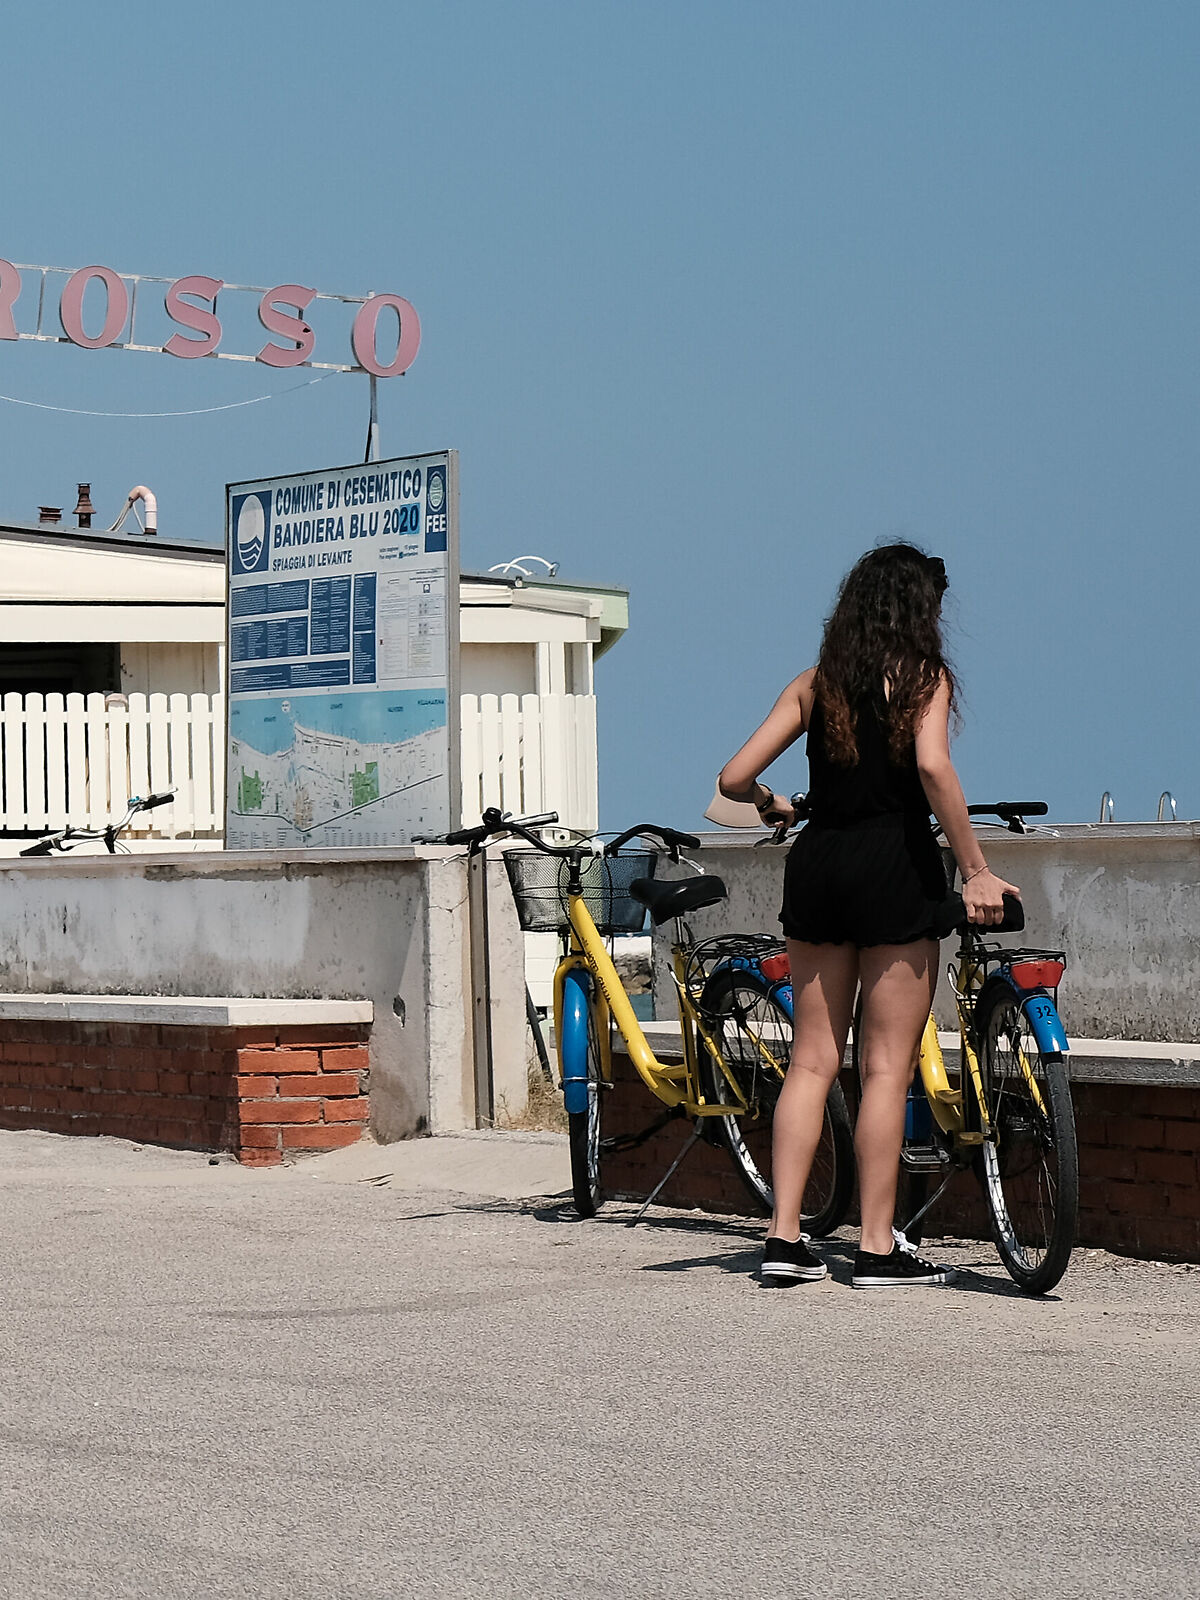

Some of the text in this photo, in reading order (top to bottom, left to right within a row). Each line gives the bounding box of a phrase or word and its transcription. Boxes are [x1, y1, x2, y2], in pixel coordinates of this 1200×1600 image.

[275, 468, 422, 516] COMUNE DI CESENATICO
[274, 505, 420, 548] BANDIERA BLU 2020
[426, 514, 446, 533] FEE
[272, 550, 352, 572] SPIAGGIA DI LEVANTE
